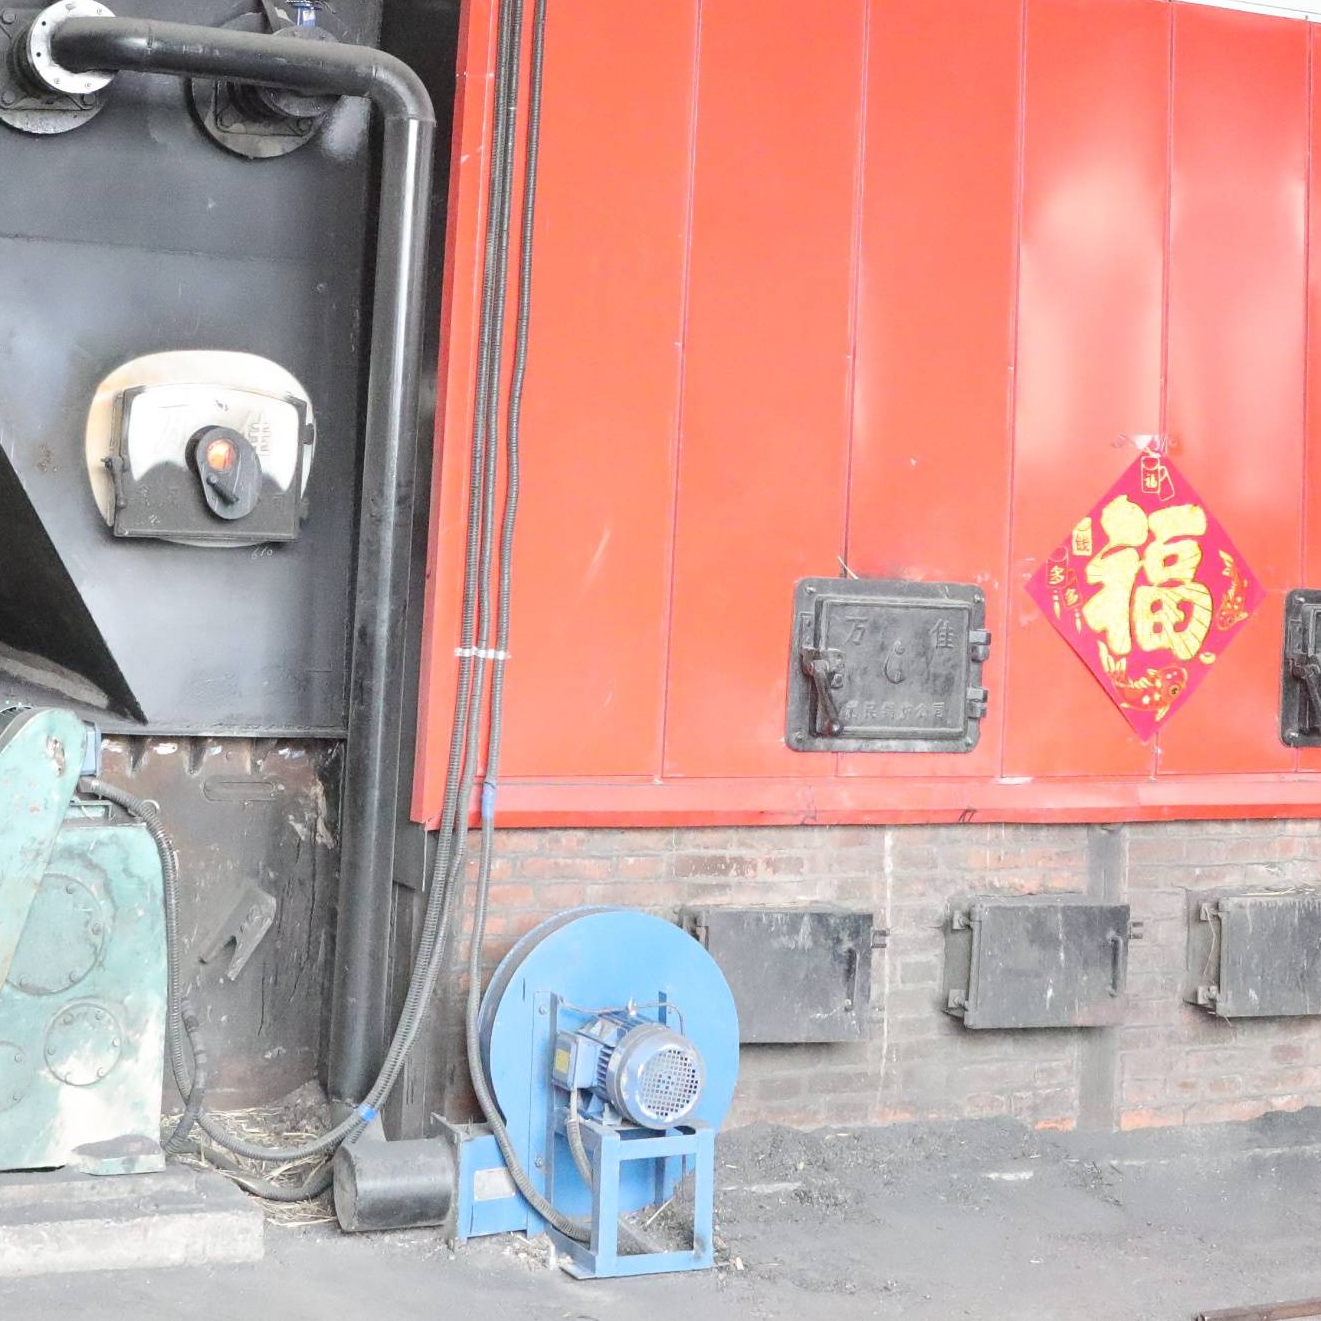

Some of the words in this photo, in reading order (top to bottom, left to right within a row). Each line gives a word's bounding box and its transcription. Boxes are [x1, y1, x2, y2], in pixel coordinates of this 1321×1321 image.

[1082, 494, 1214, 662] 福
[841, 615, 869, 646] 万
[928, 617, 956, 650] 佳
